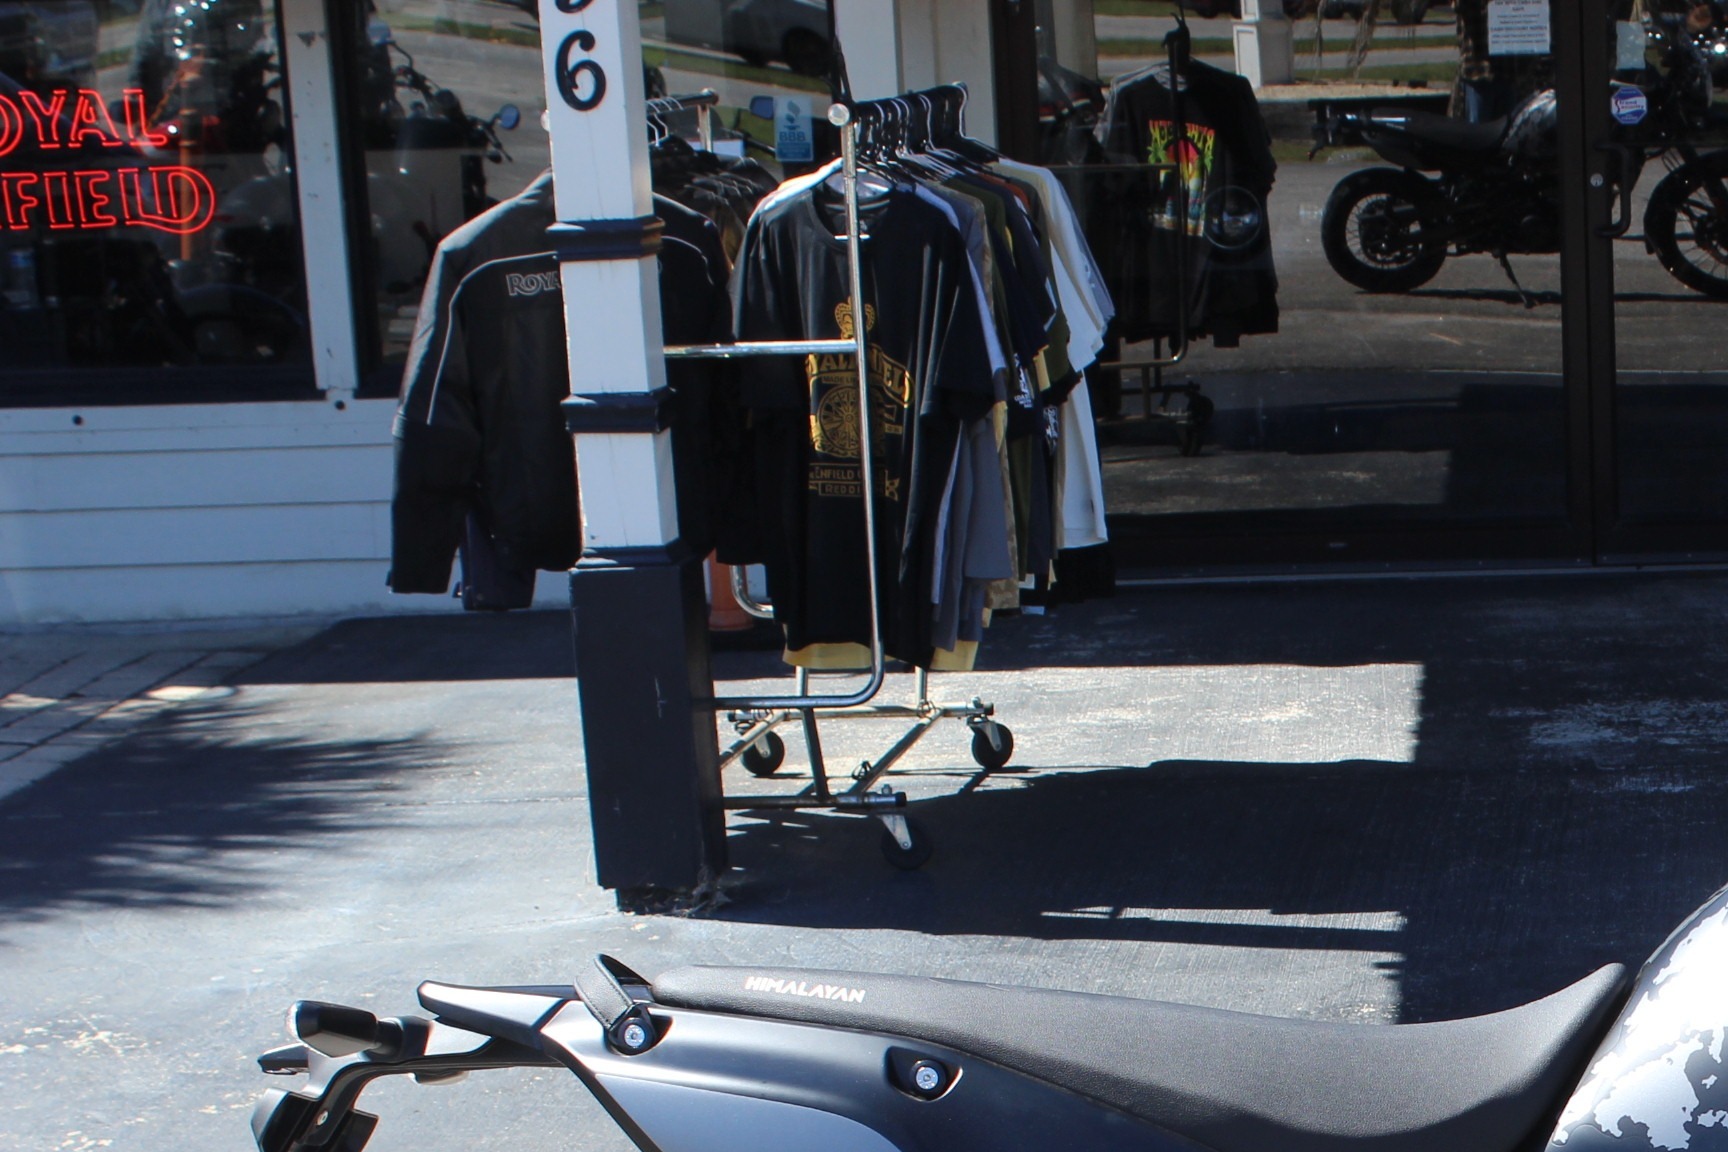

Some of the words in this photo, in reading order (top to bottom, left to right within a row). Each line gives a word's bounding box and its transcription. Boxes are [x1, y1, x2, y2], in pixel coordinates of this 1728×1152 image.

[555, 29, 607, 112] 6
[0, 88, 168, 156] YAL
[0, 165, 216, 234] FIELD
[506, 271, 562, 296] ROYA
[825, 484, 861, 494] REDDI
[744, 976, 867, 1004] HIMALAYAN
